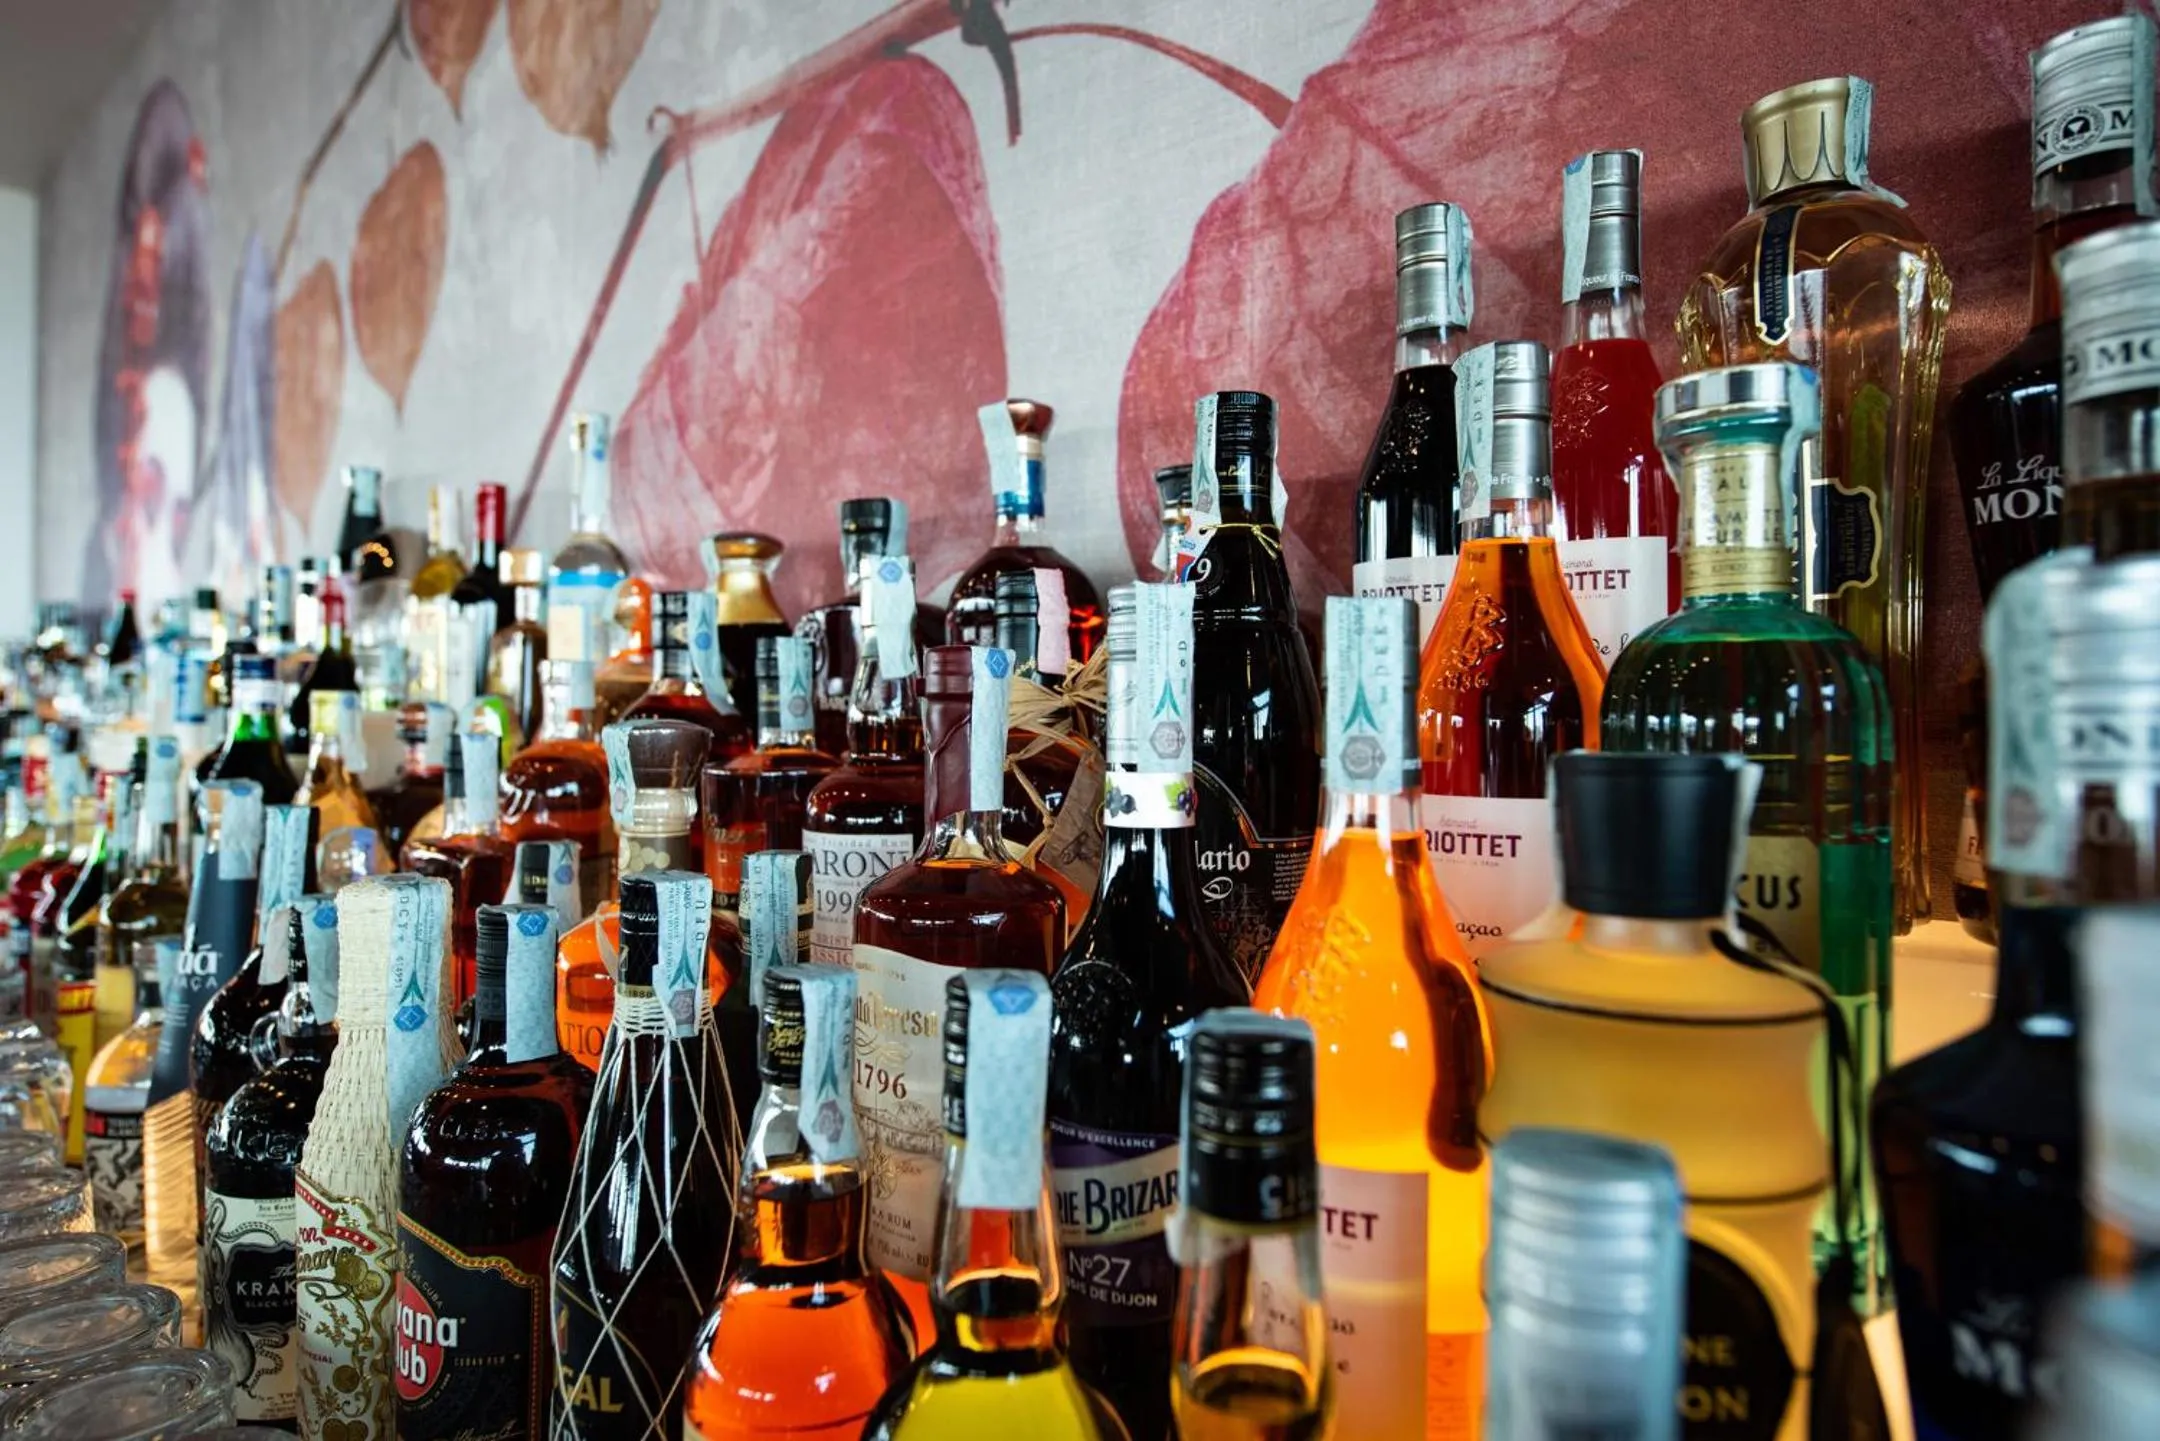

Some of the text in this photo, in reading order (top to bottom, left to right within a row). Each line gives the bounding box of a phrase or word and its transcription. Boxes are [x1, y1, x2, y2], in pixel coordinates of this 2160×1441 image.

[817, 889, 857, 914] 199
[856, 1059, 908, 1100] 1796
[1111, 1290, 1158, 1307] DIJON
